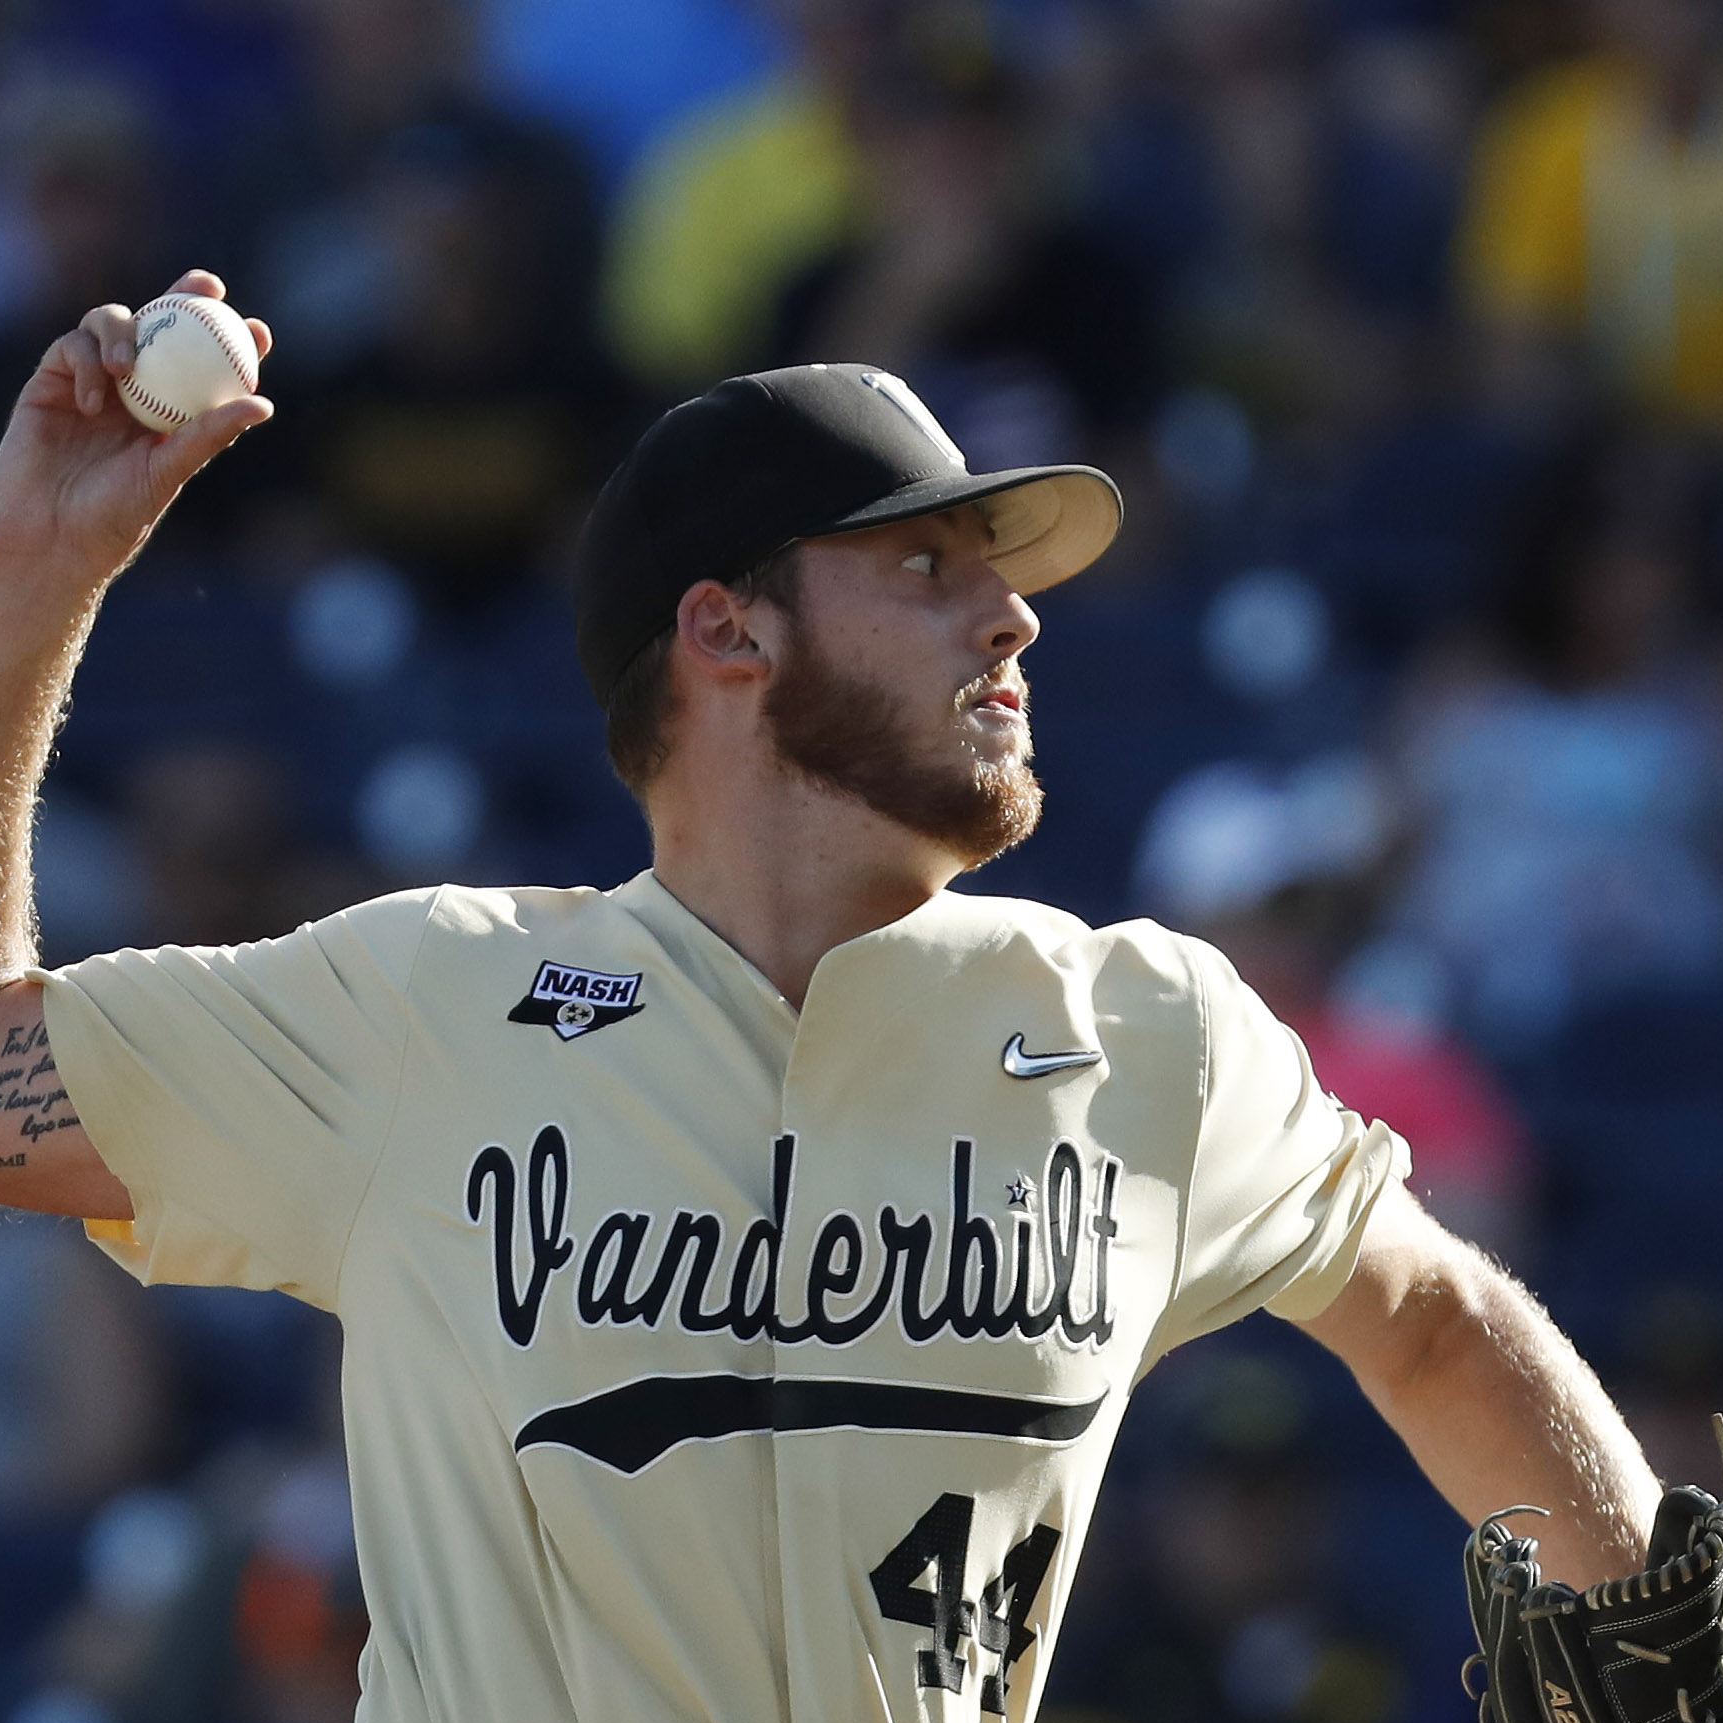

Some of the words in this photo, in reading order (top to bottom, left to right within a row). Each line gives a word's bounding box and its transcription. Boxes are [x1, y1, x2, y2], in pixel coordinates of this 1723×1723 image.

[539, 968, 635, 1003] NASH
[466, 1122, 1123, 1352] Vanderbilt
[869, 1491, 1063, 1716] 44
